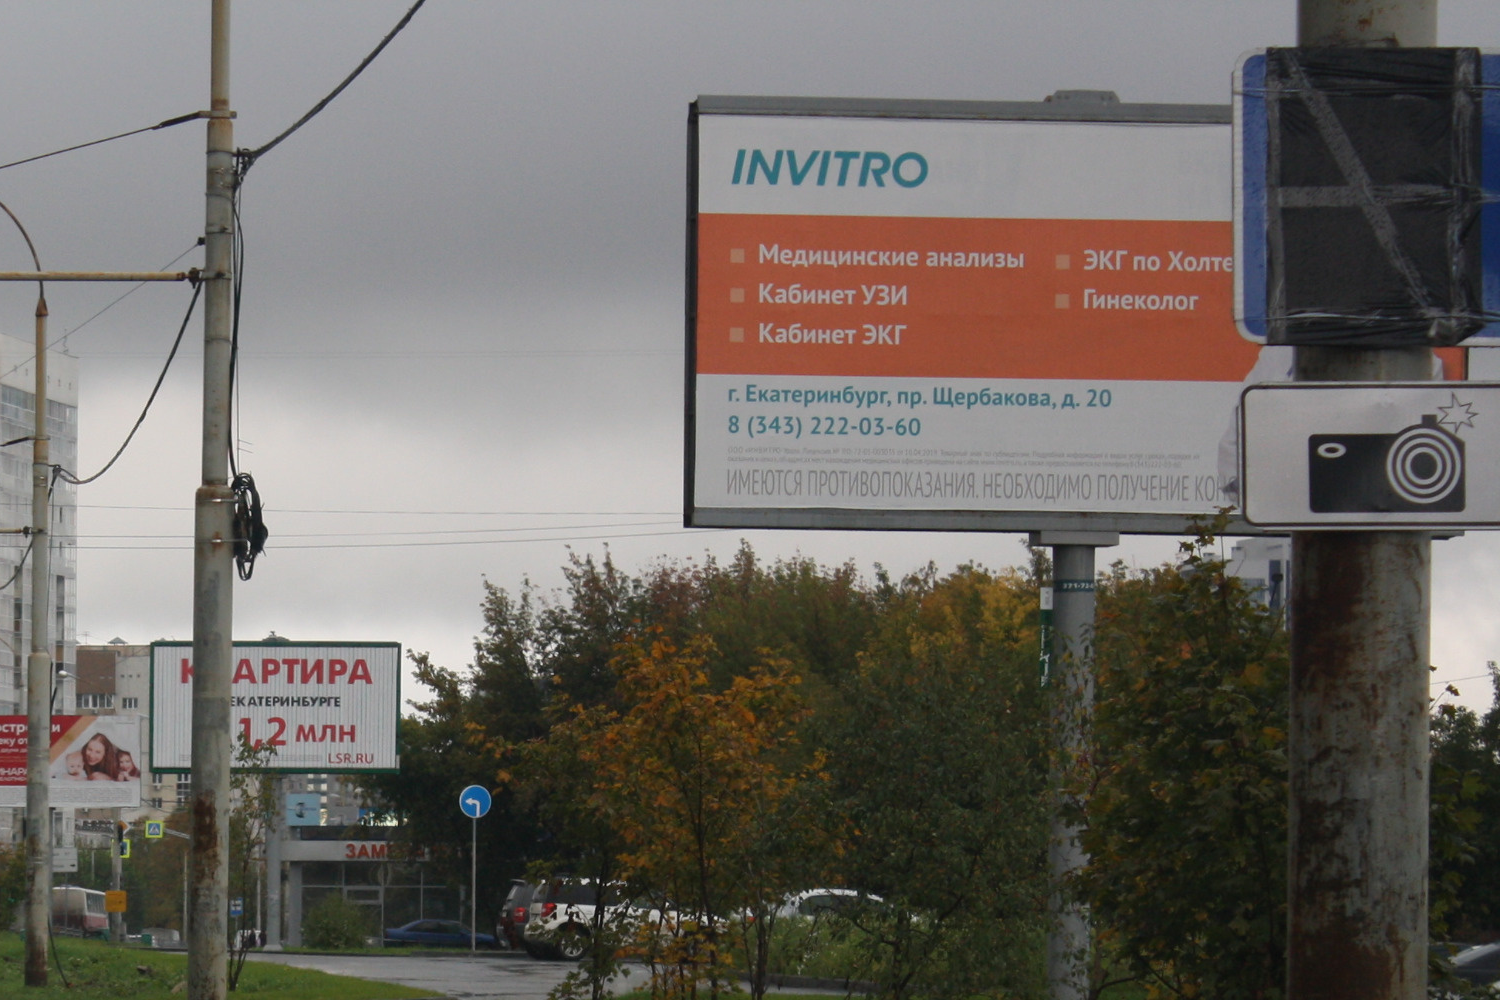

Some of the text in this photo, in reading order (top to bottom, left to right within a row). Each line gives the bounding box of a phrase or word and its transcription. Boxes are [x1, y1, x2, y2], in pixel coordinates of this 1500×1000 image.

[731, 149, 929, 188] INVITRO
[759, 244, 1024, 268] Медицинские анализы
[1084, 249, 1128, 270] ЭКГ
[1133, 255, 1161, 271] по
[759, 283, 908, 305] Кабинет УЗИ
[1084, 289, 1199, 310] Гинеколог
[759, 322, 907, 345] Кабинет ЭКГ
[728, 385, 1112, 409] г. Екатеринбург, пр. Щербакова, д. 20
[728, 415, 921, 438] 8 (343) 222-03-60
[726, 469, 802, 497] ИМЕЮТСЯ
[808, 470, 979, 499] ПРОТИВОПОКАЗАНИЯ.
[983, 473, 1092, 503] НЕОБХОДИМО
[1097, 474, 1190, 501] ПОЛУЧЕНИЕ
[181, 658, 373, 684] КАРТИРА
[239, 717, 287, 750] 1,2
[328, 753, 374, 764] LSR.RU
